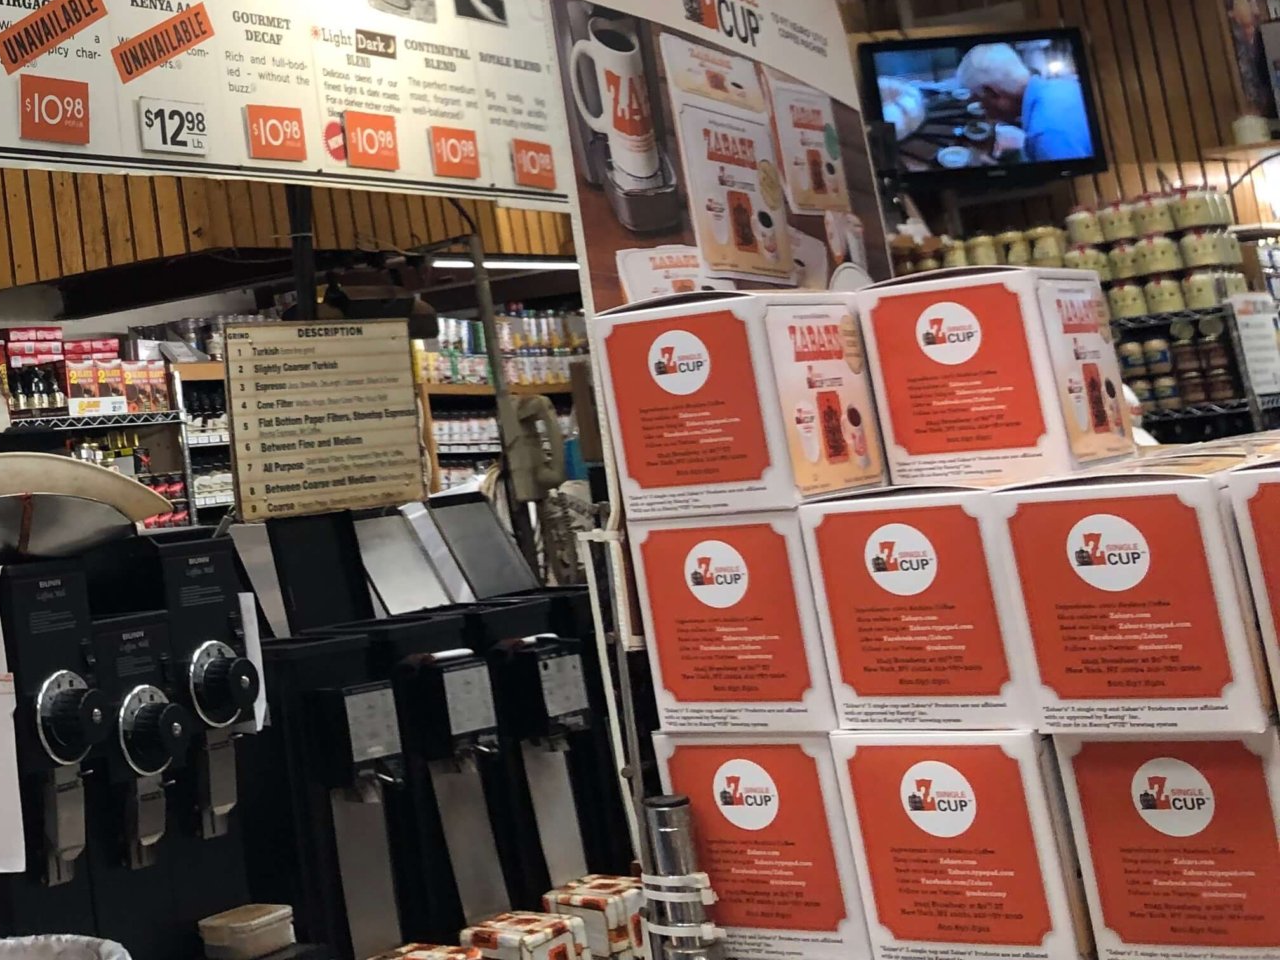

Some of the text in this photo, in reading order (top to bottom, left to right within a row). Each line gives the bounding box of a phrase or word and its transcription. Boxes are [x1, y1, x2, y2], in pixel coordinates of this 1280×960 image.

[232, 10, 291, 30] GOURMET
[119, 11, 208, 76] UNAVAILABLE
[245, 29, 283, 45] DECAF
[321, 27, 386, 54] Light Dark
[404, 38, 471, 61] CONTINENTAL
[225, 50, 244, 63] Rich
[250, 54, 266, 66] and
[424, 56, 457, 73] BLEND
[258, 71, 310, 86] without the
[297, 326, 363, 339] DESCRIPTION
[947, 330, 975, 344] CUP
[900, 559, 930, 572] CUP
[1107, 551, 1141, 566] CUP
[937, 799, 968, 812] CUP
[1172, 797, 1206, 811] CUP
